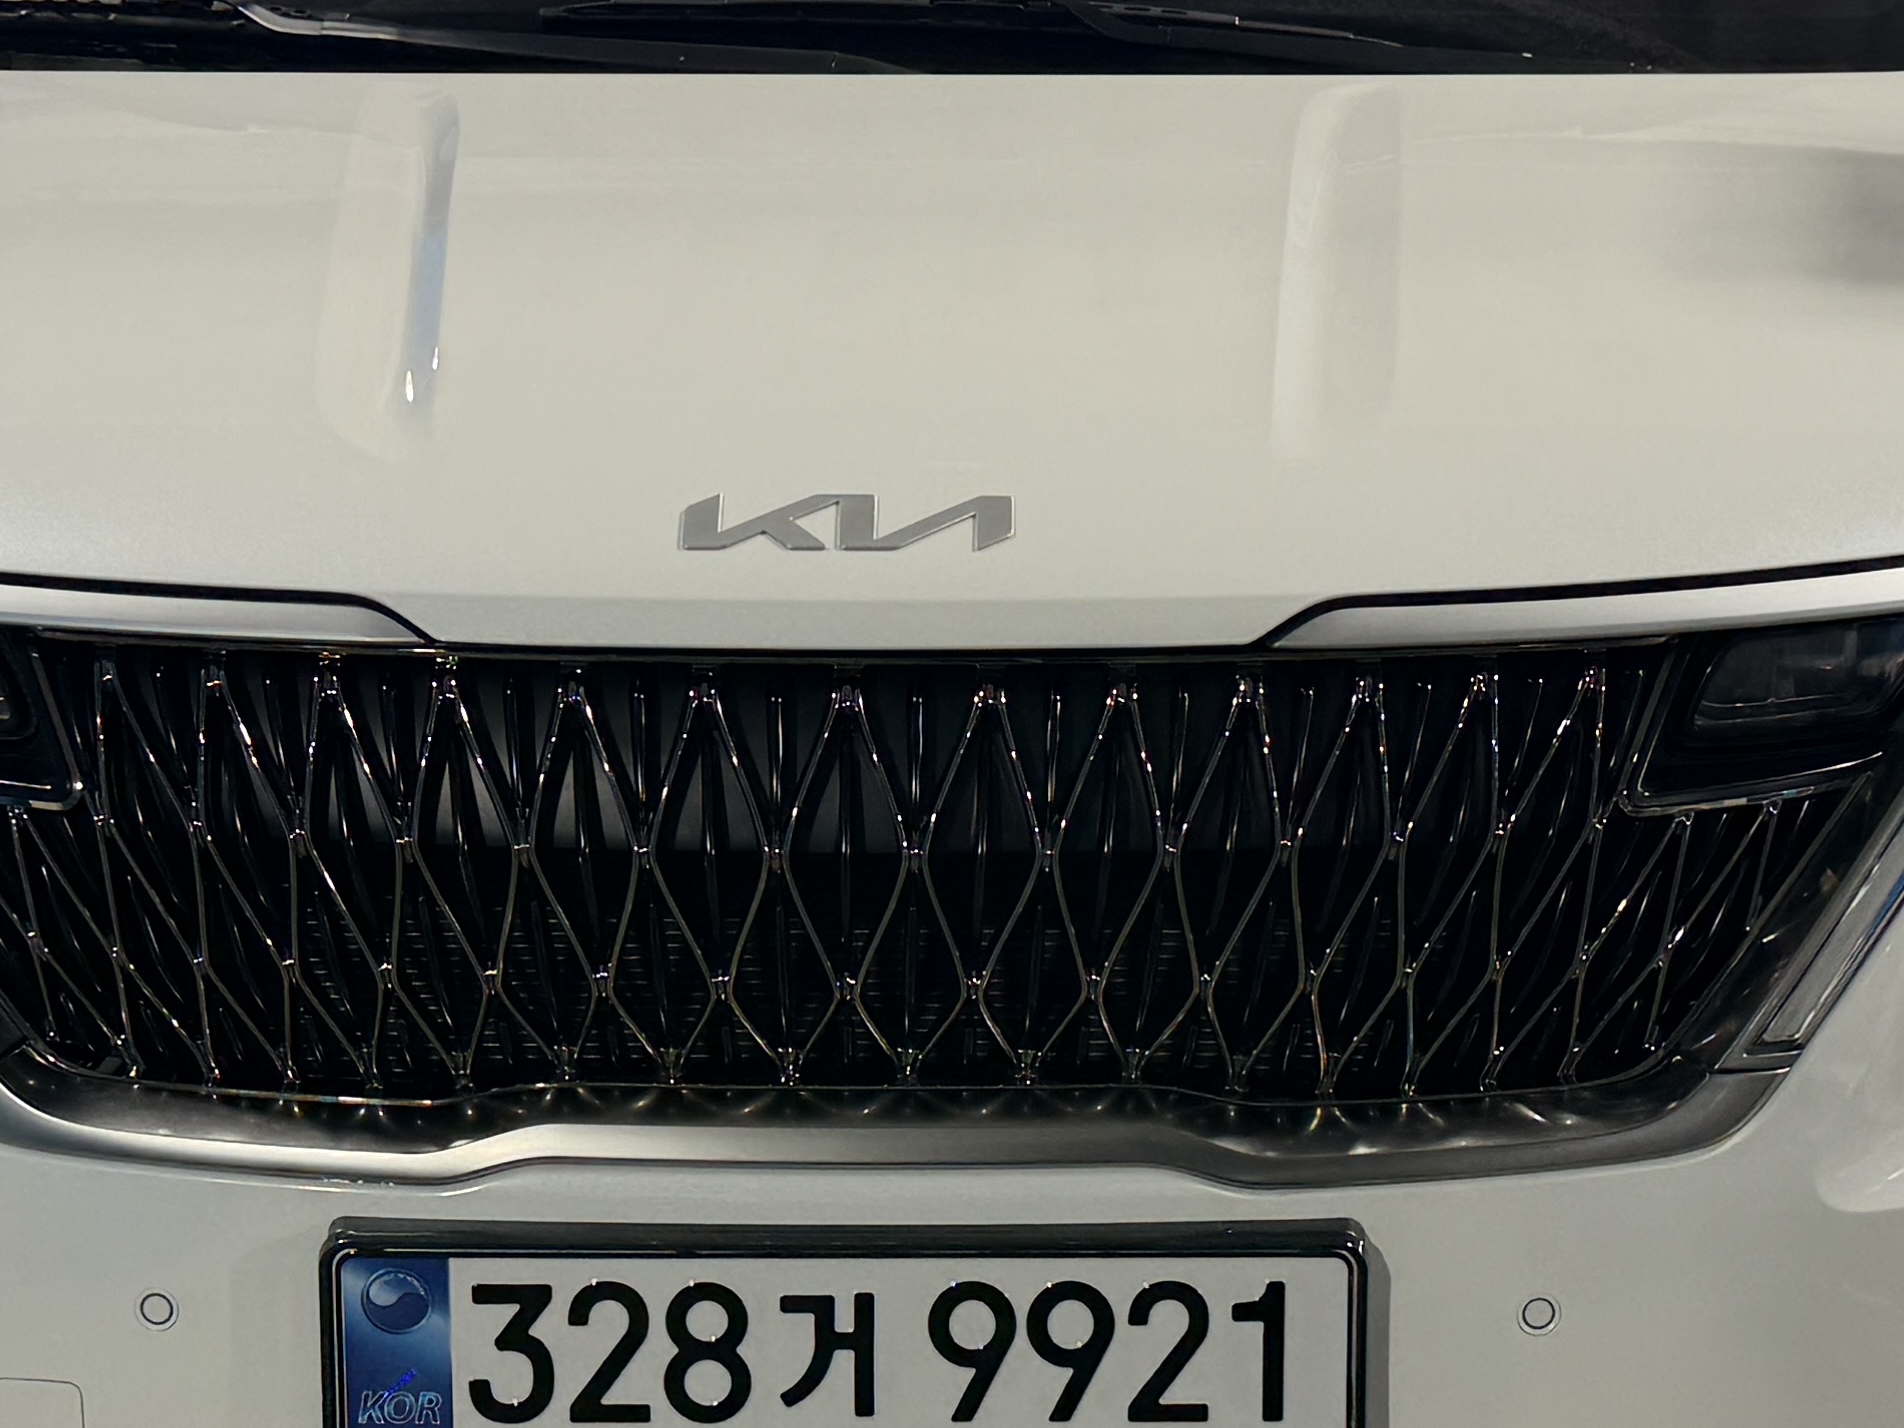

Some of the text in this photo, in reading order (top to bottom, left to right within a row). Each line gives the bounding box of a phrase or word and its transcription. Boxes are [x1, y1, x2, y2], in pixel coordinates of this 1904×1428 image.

[469, 1280, 1286, 1425] 328거 9921
[358, 1391, 442, 1425] KOR
